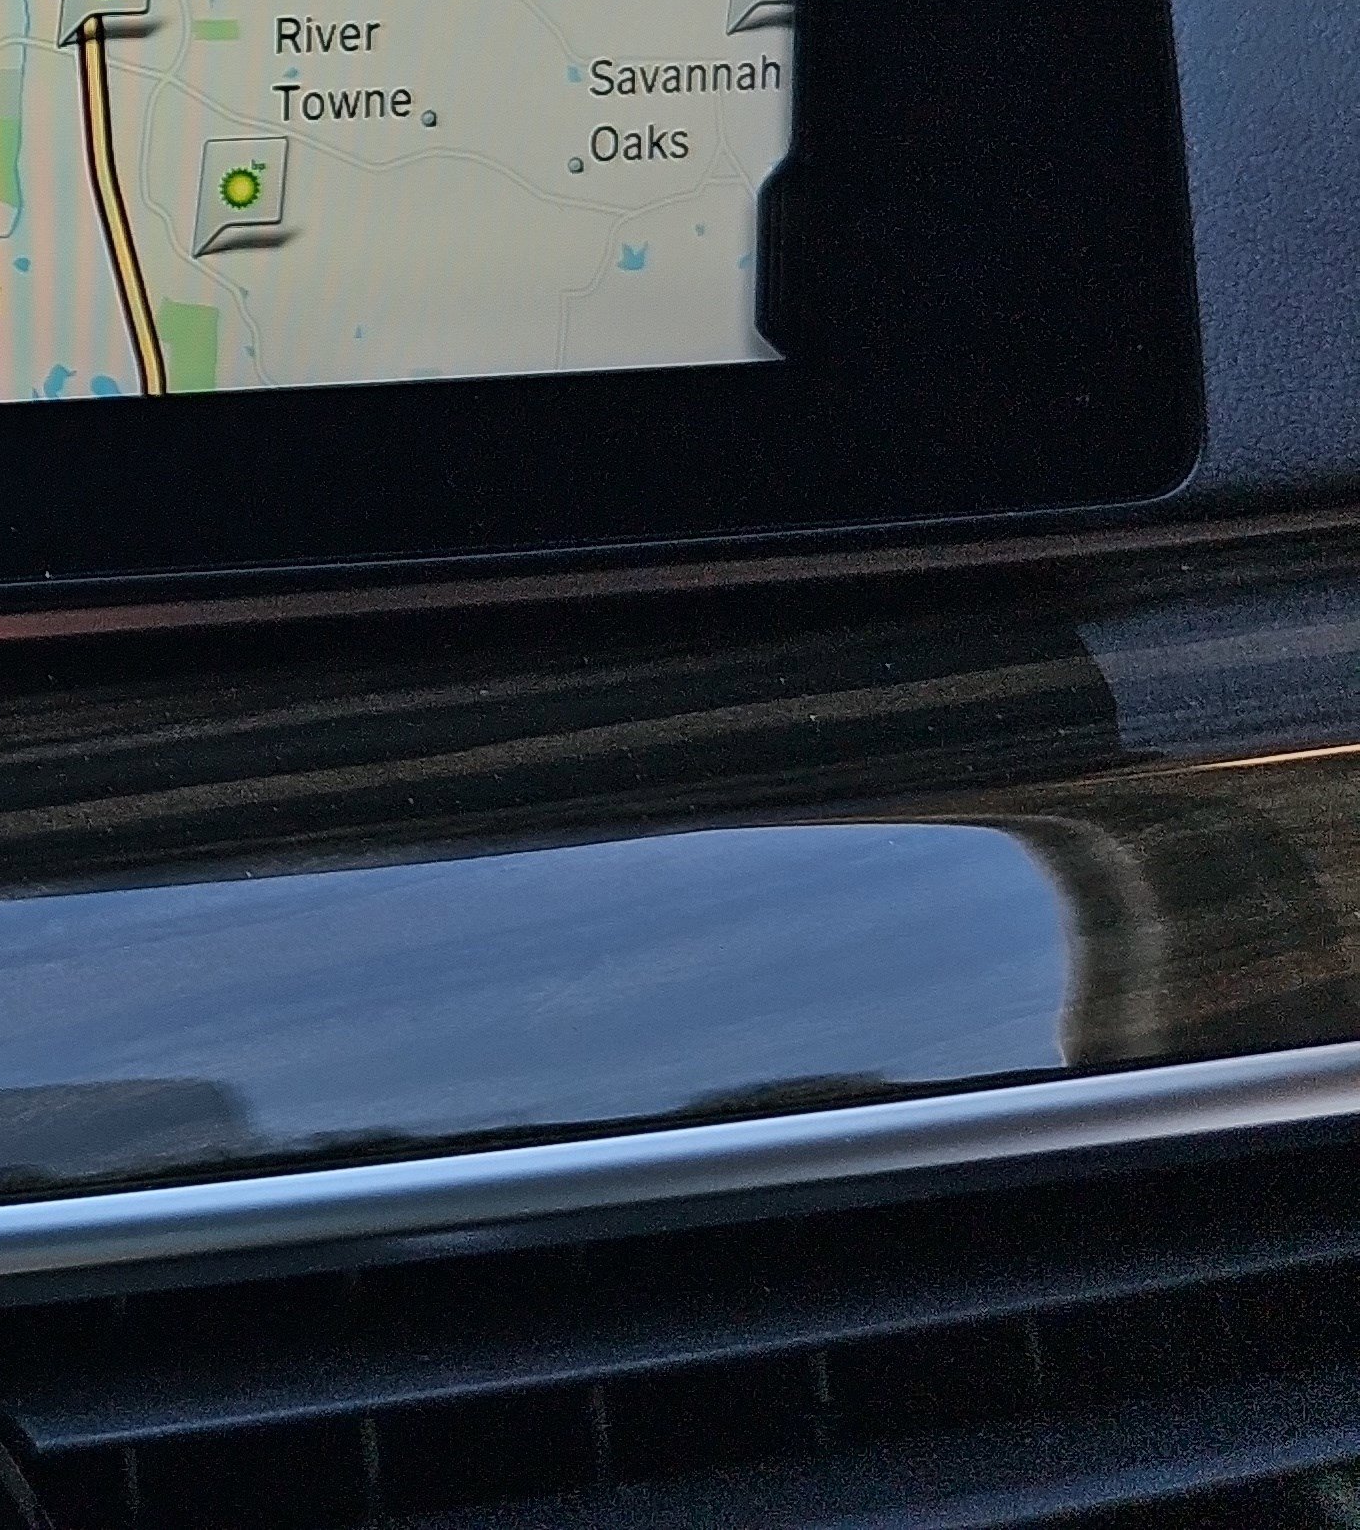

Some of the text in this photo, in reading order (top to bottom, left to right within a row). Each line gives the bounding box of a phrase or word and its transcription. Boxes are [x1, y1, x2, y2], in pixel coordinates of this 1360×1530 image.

[275, 16, 381, 56] River
[589, 55, 782, 97] Savannah
[272, 86, 412, 122] Towne
[590, 125, 690, 162] Oaks
